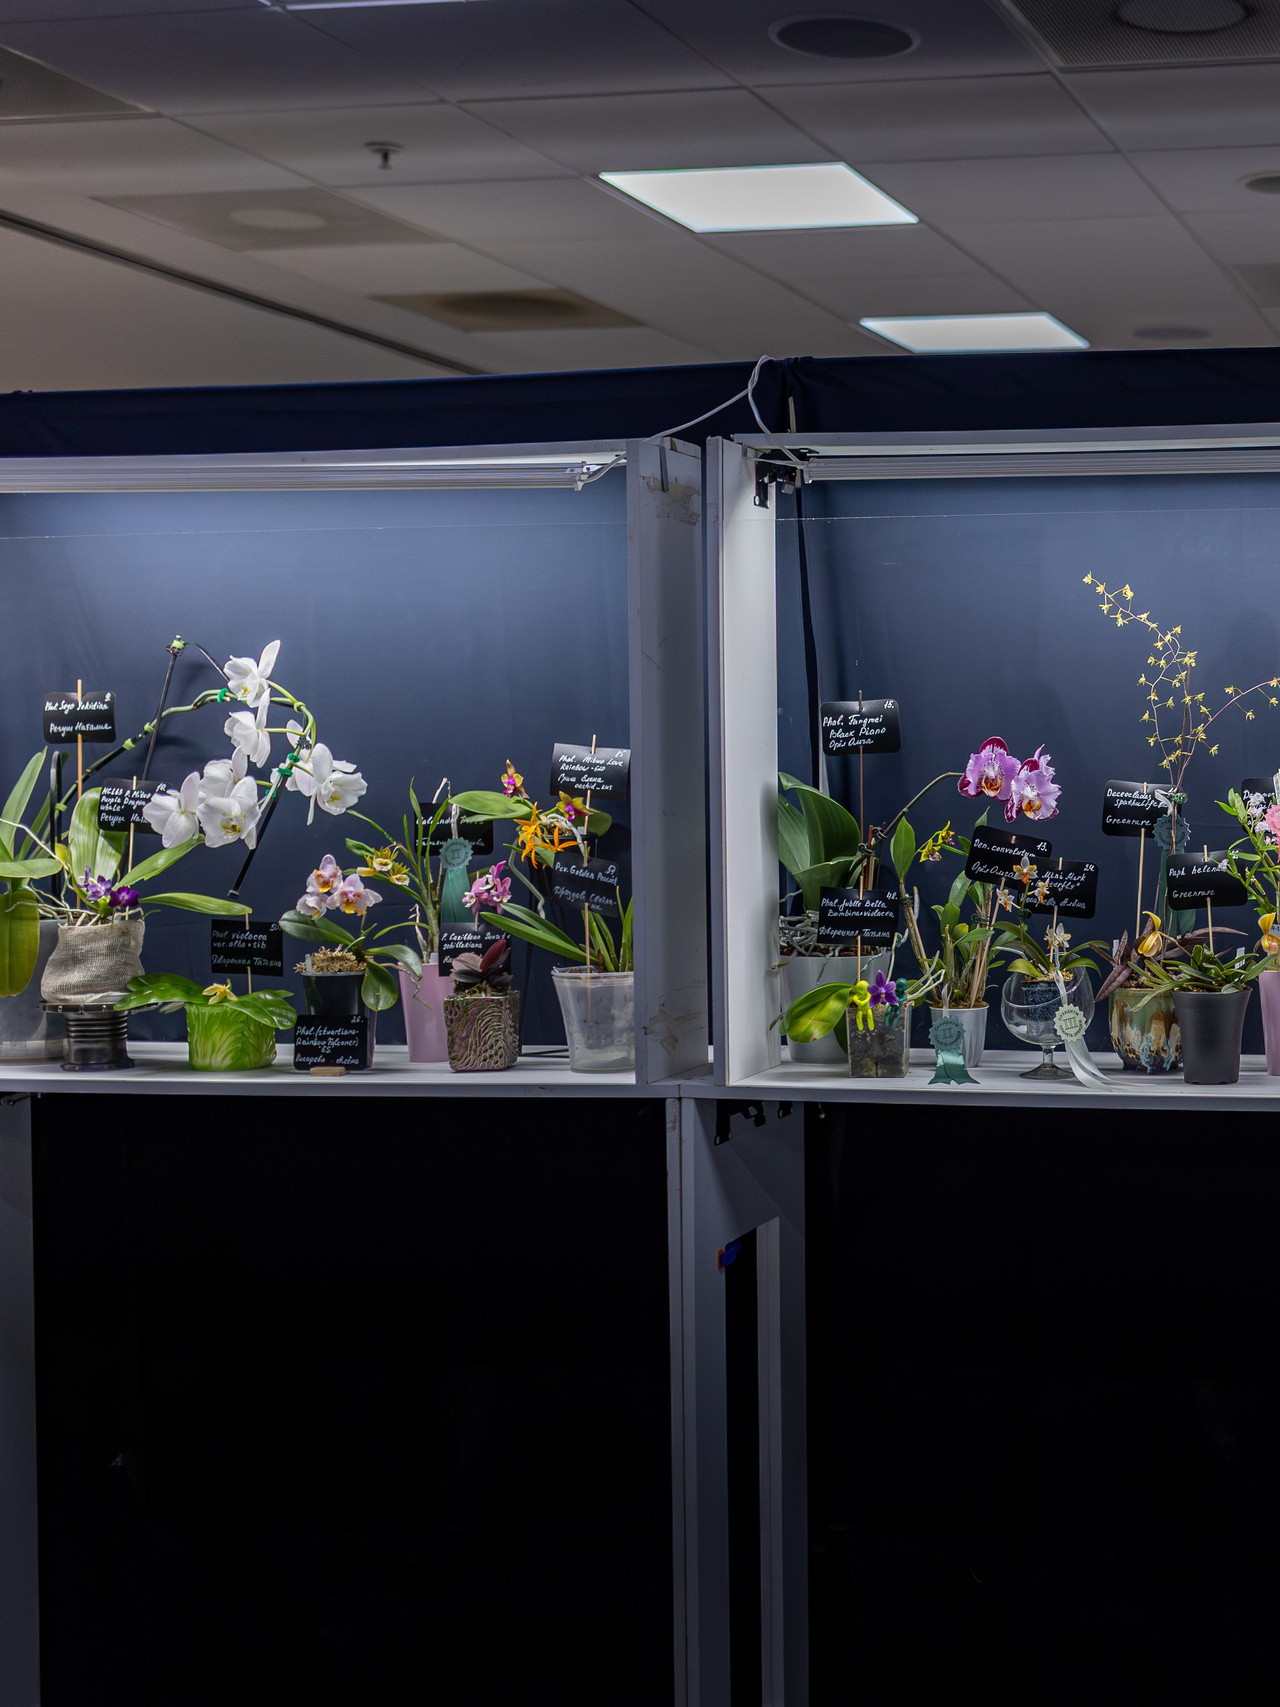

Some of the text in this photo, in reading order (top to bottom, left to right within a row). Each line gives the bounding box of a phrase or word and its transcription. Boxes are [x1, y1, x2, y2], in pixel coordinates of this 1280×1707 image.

[883, 700, 894, 709] 15.
[822, 714, 844, 728] Phal.
[859, 727, 886, 737] Piano
[973, 838, 990, 850] Den.
[1036, 841, 1048, 852] 13.
